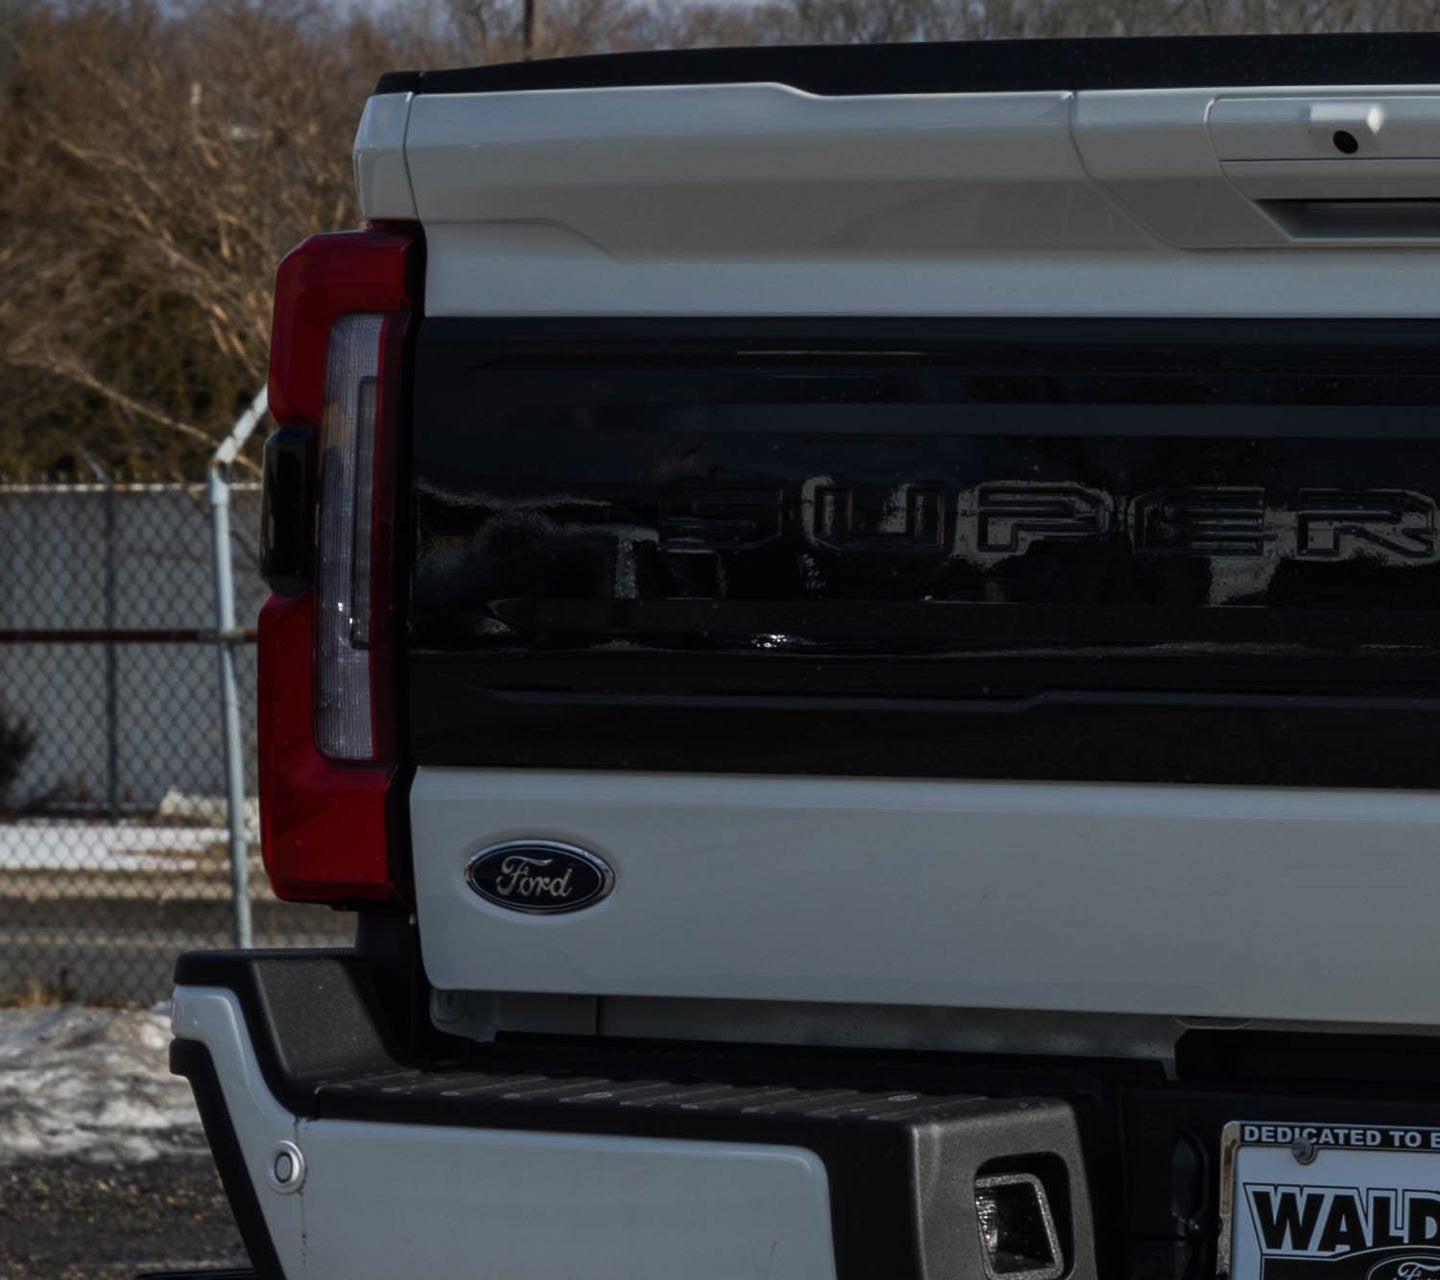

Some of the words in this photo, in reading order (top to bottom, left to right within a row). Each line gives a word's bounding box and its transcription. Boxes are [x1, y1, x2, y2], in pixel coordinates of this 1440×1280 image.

[496, 856, 573, 897] Ford
[1243, 1125, 1382, 1147] DEDICATED
[1389, 1130, 1421, 1148] TO
